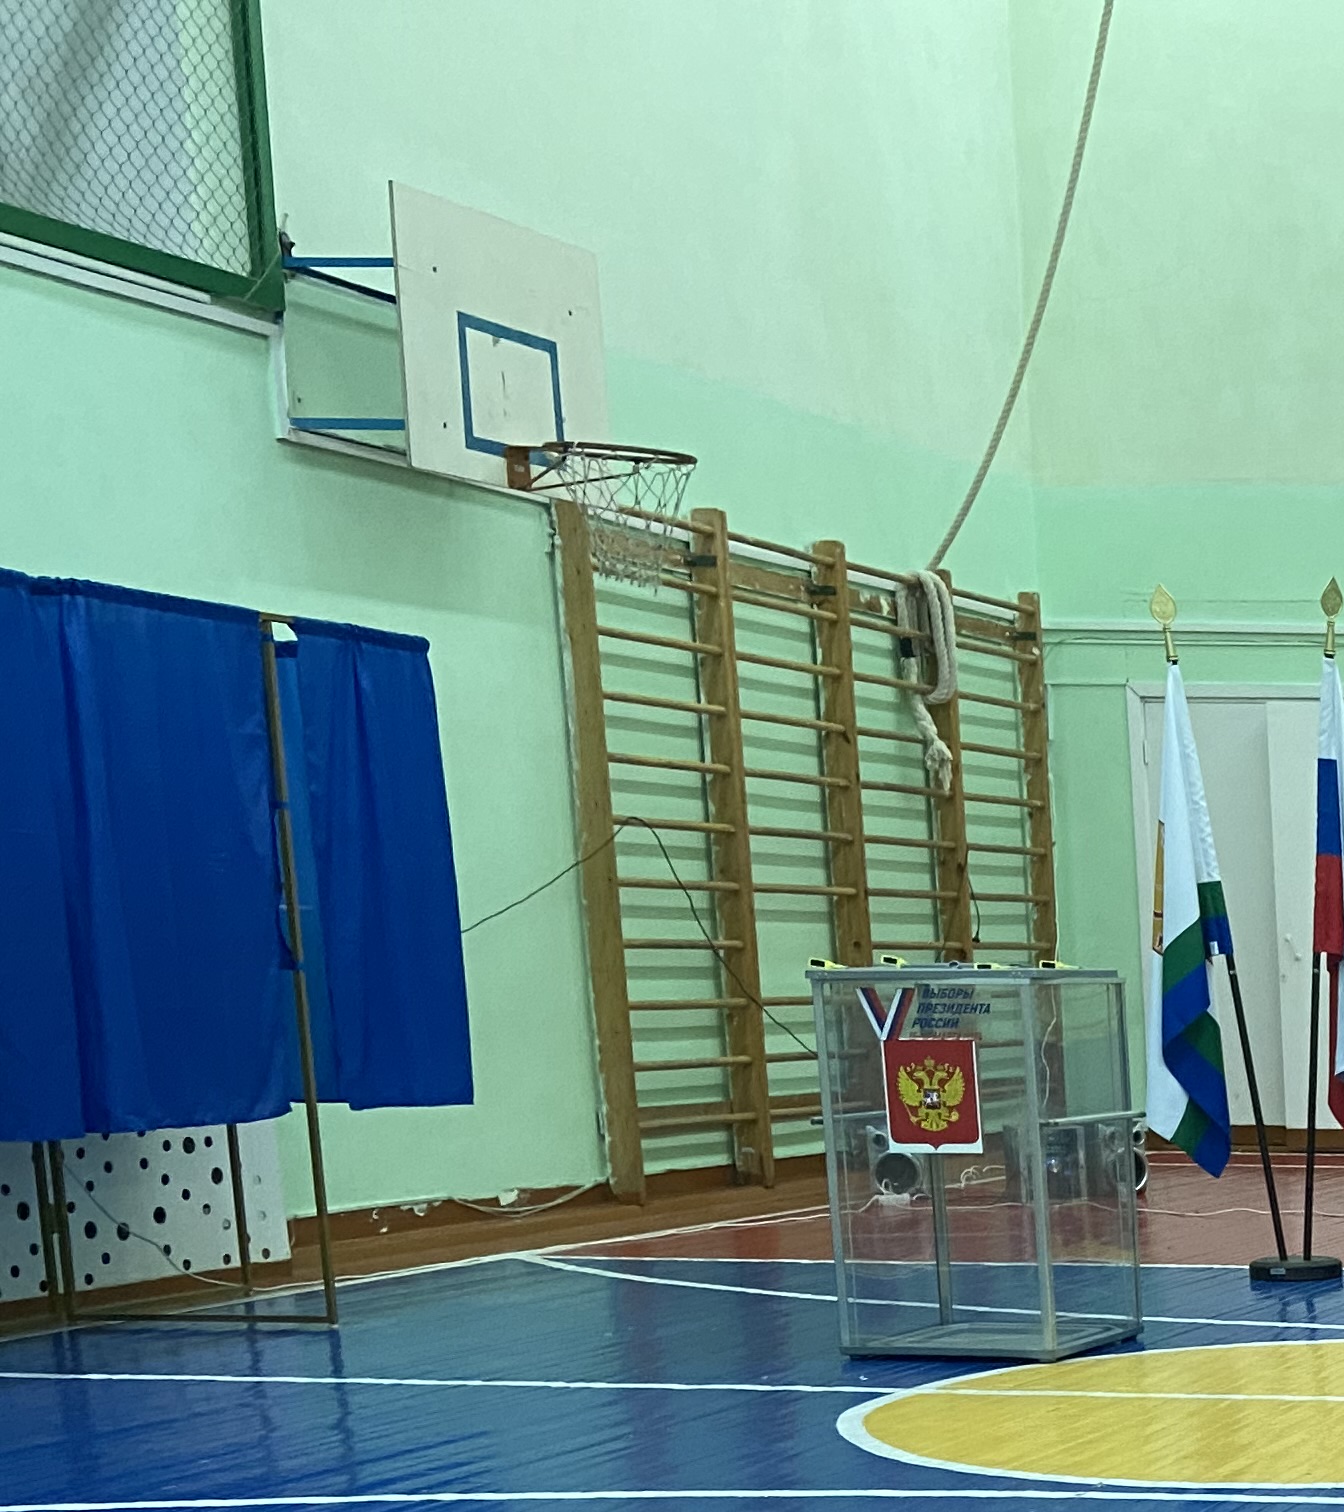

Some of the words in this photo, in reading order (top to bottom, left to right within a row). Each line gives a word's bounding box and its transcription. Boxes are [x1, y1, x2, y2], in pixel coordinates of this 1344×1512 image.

[921, 987, 975, 999] ВЫБОРЫ
[916, 1003, 991, 1015] ПРЕЗИДЕНТА
[911, 1018, 959, 1029] РОССИИ
